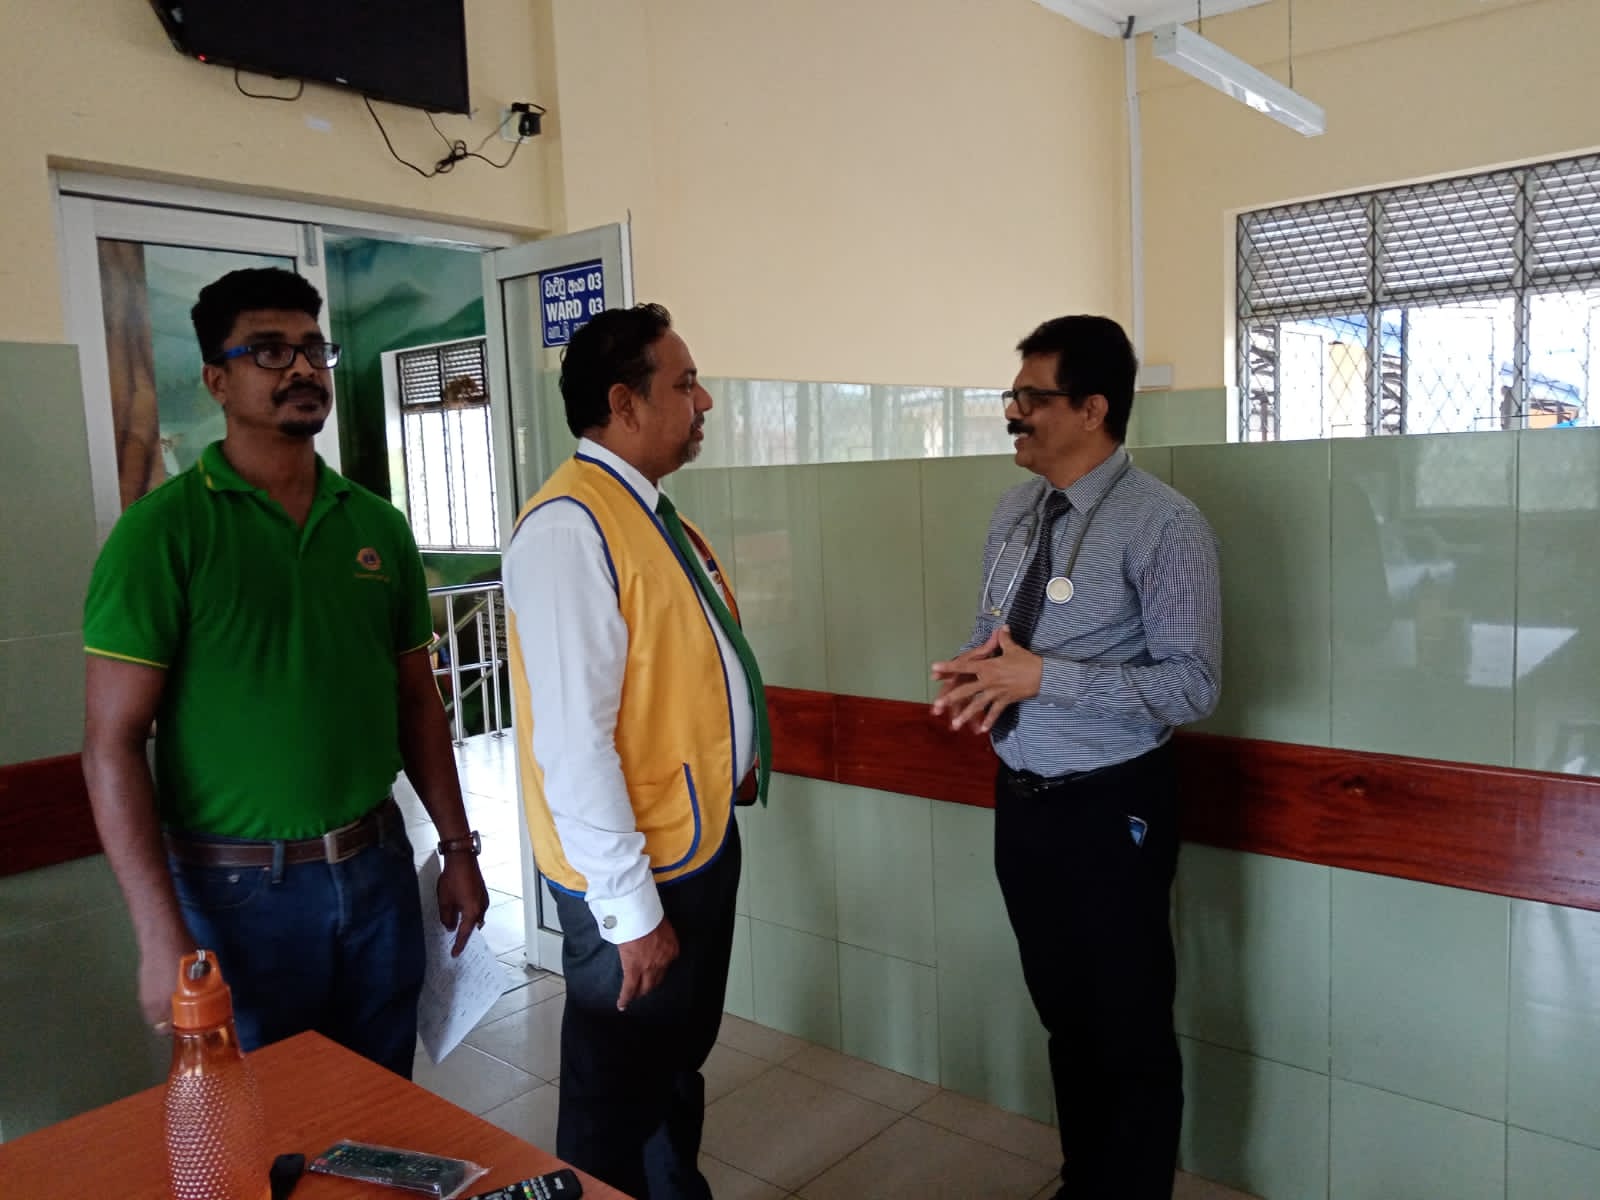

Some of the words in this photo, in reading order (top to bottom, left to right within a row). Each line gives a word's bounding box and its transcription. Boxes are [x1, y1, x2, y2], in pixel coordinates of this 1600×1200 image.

[587, 272, 602, 291] 03
[546, 299, 582, 322] WARD
[588, 298, 603, 315] 03
